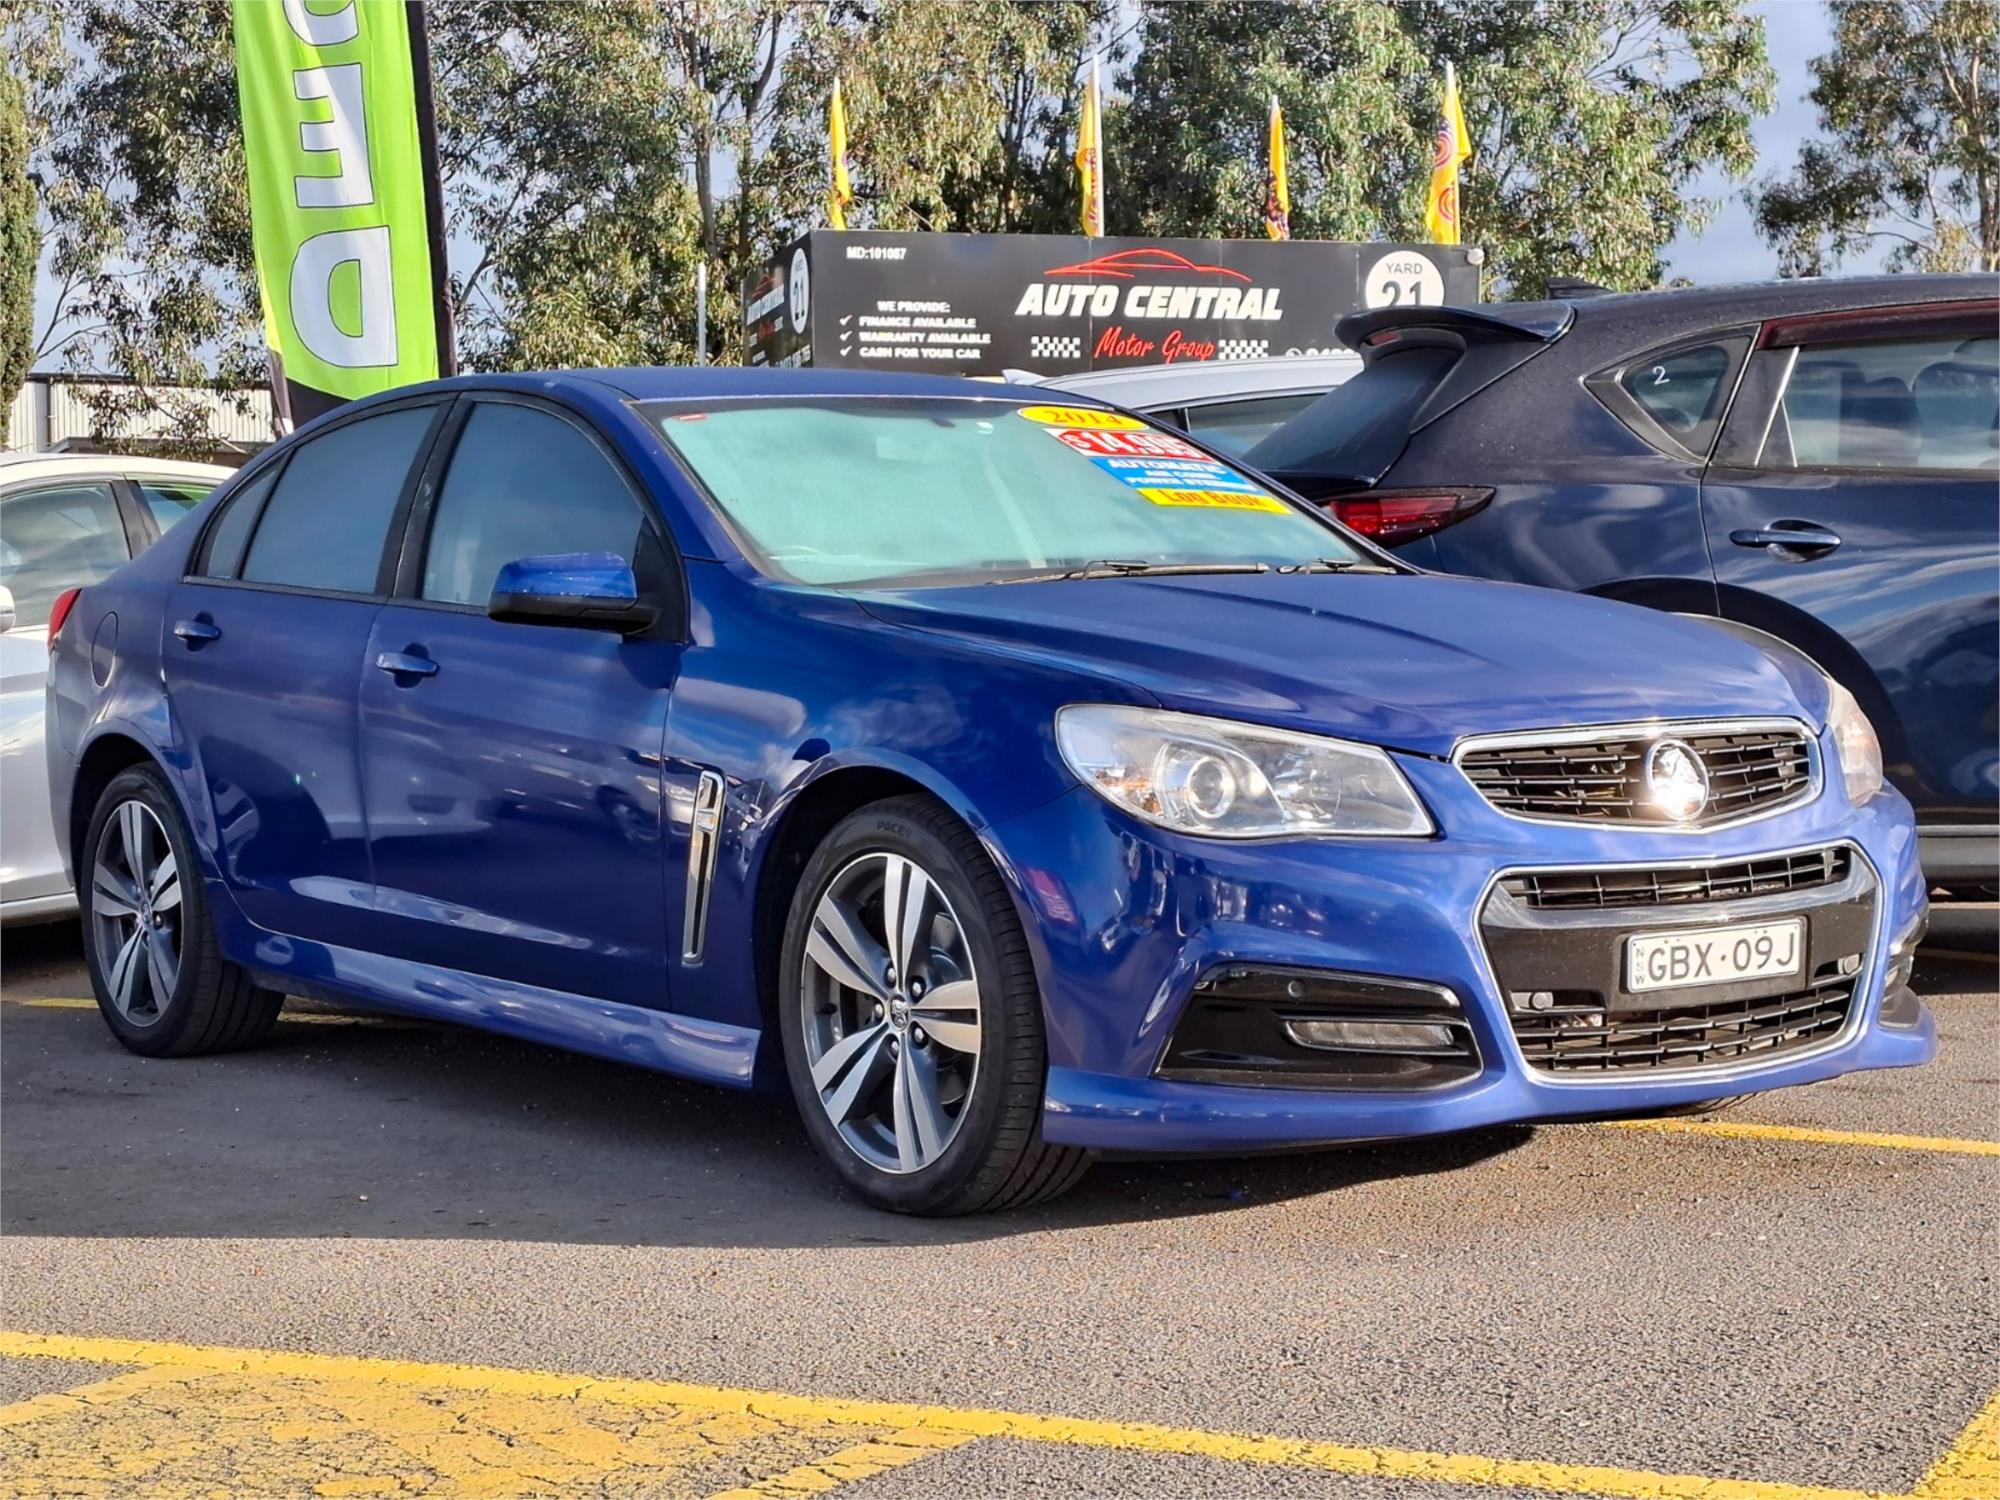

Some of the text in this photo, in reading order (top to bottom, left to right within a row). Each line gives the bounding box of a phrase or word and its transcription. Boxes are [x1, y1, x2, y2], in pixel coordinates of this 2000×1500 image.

[1386, 263, 1423, 275] YARD
[1381, 280, 1423, 306] 21
[877, 301, 950, 313] WE PROVIDE:
[1014, 284, 1283, 320] AUTO CENTRAL
[859, 316, 977, 328] FINANCE AVAILABLE
[859, 332, 991, 344] WARRANTY AVAILABLE
[1094, 326, 1216, 364] Motor Group
[860, 348, 981, 359] CASH FOR YOUR CAR
[1652, 366, 1670, 385] 2
[1043, 410, 1124, 425] 2014
[1108, 459, 1227, 474] AUTOMATIC
[1160, 489, 1268, 508] Log Book
